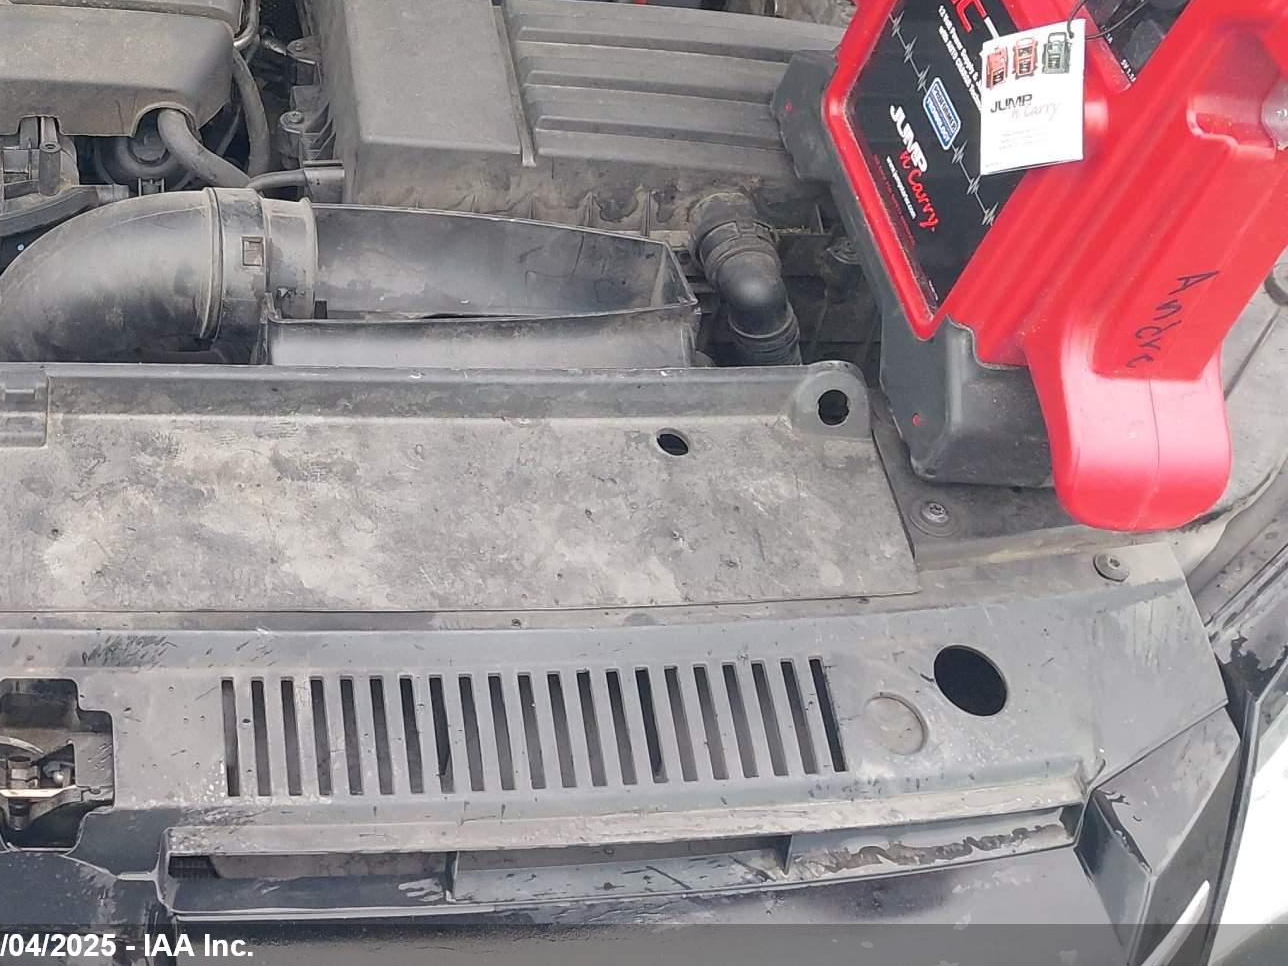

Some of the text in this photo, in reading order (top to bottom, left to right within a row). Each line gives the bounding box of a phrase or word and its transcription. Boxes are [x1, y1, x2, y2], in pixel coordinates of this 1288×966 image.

[949, 26, 964, 51] Power
[960, 47, 975, 75] Supply
[989, 93, 1034, 114] JUMP
[890, 105, 928, 172] JUMP
[907, 168, 939, 228] Carry
